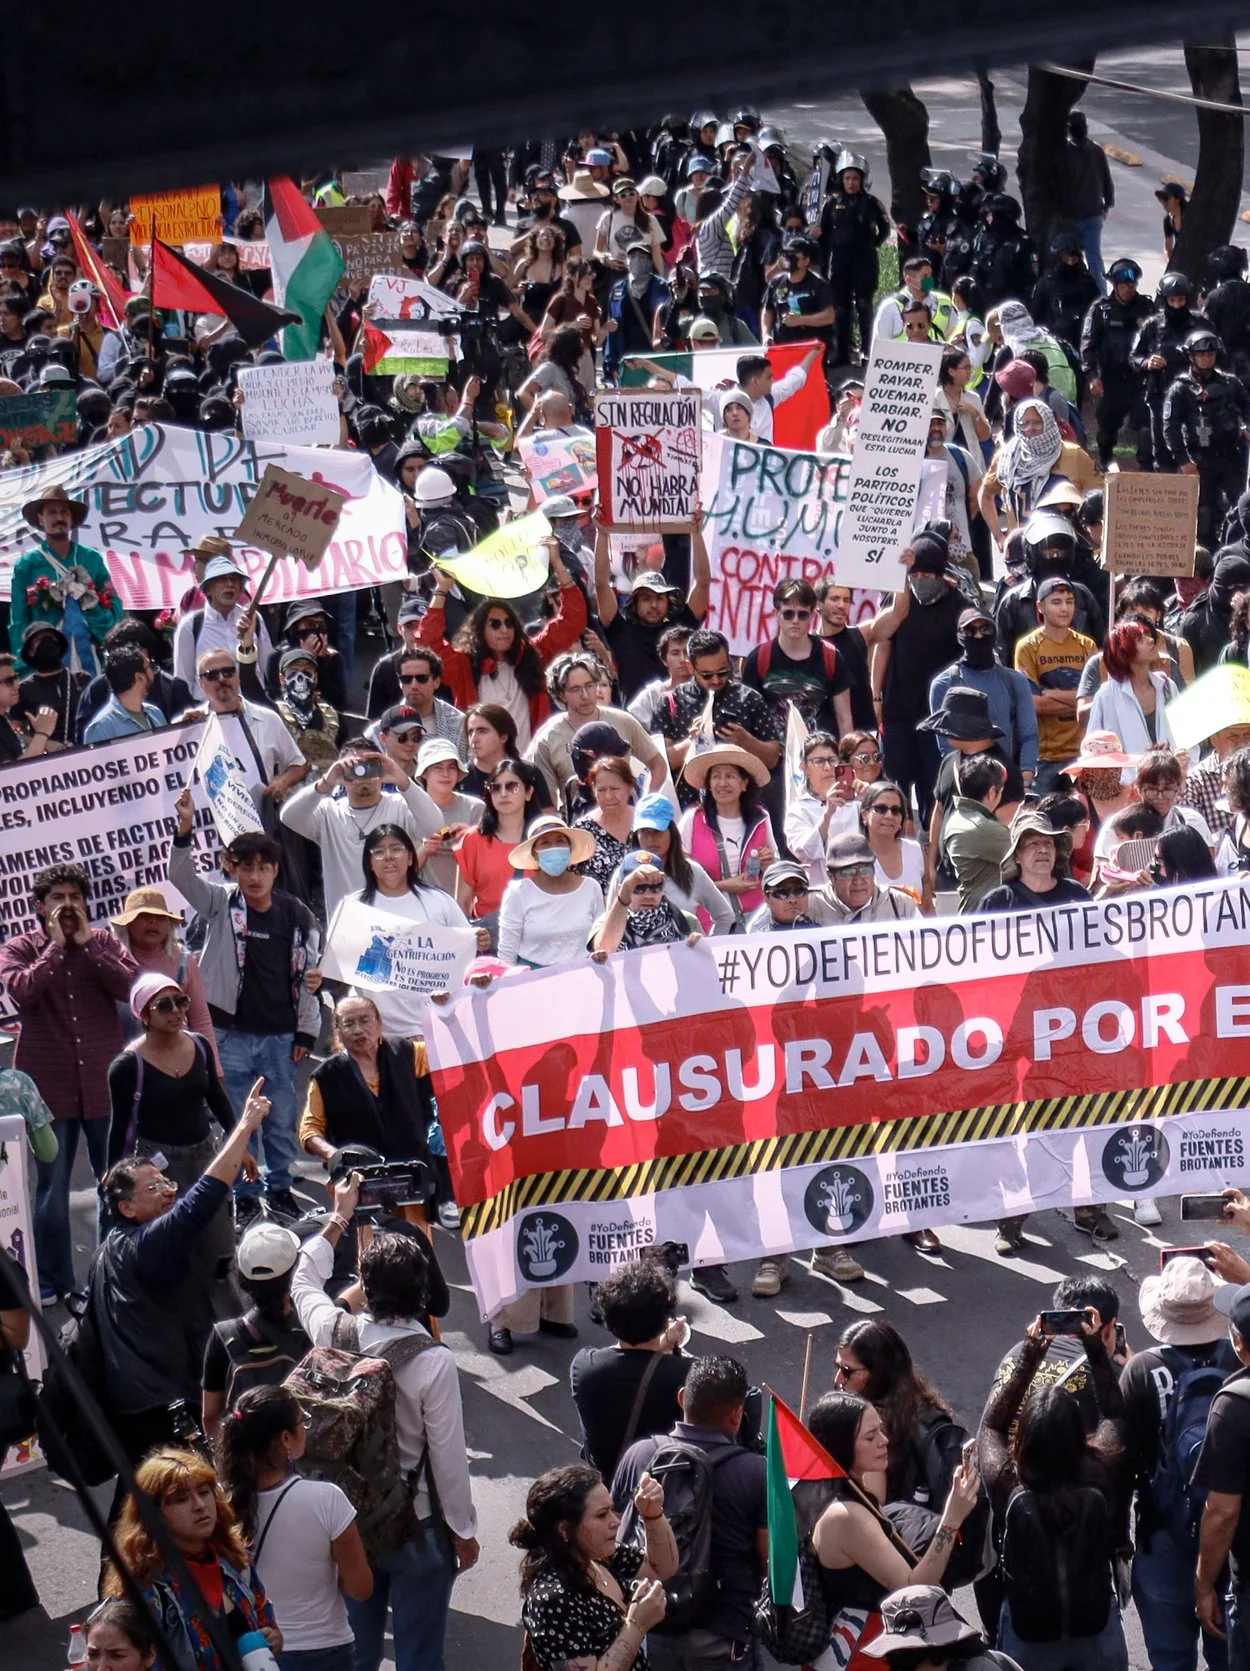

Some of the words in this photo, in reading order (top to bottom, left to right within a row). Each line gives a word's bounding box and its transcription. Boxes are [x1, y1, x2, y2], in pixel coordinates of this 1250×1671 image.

[873, 358, 934, 376] ROMPER,
[878, 374, 925, 389] RAYAR,
[263, 396, 314, 411] LUCHA
[868, 388, 929, 405] QUEMAR,
[597, 402, 627, 428] SIN
[630, 396, 697, 428] REGULACIÓN
[869, 403, 922, 419] RABIAR,
[880, 418, 908, 433] NO
[860, 432, 926, 447] DESLEGITIMAN
[865, 443, 887, 453] ESTA
[887, 446, 917, 456] LUCHA
[875, 466, 899, 478] LOS
[616, 476, 641, 498] NO
[854, 477, 916, 494] PARTIDOS
[619, 496, 696, 518] MUNDIAL
[850, 491, 914, 508] POLÍTICOS
[849, 504, 868, 514] QUE
[257, 513, 308, 542] MERCADO
[856, 515, 902, 527] LUCHARLA
[858, 524, 888, 535] JUNTO
[865, 548, 886, 564] SÍ
[1040, 655, 1085, 666] Banamex
[0, 758, 130, 804] ROPIANDOSE
[133, 751, 160, 773] DE
[0, 809, 33, 832] ES,
[36, 778, 160, 823] INCLUYENDO
[164, 770, 188, 792] EL
[77, 834, 105, 858] DE
[118, 850, 141, 870] DE
[418, 936, 434, 949] LA
[408, 977, 447, 988] DESPOJO
[416, 970, 450, 981] PROGRESO
[481, 1016, 1004, 1152] CLAUSURADO
[1033, 992, 1191, 1061] POR
[1182, 1127, 1242, 1140] #YoDefiendo
[1180, 1138, 1244, 1158] FUENTES
[1180, 1155, 1245, 1172] BROTANTES
[886, 1165, 947, 1182] #YoDefiendo
[884, 1176, 949, 1201] FUENTES
[884, 1193, 951, 1215] BROTANTES
[591, 1216, 652, 1233] #YoDefiendo
[588, 1228, 654, 1251] FUENTES
[588, 1246, 641, 1265] BROTANT
